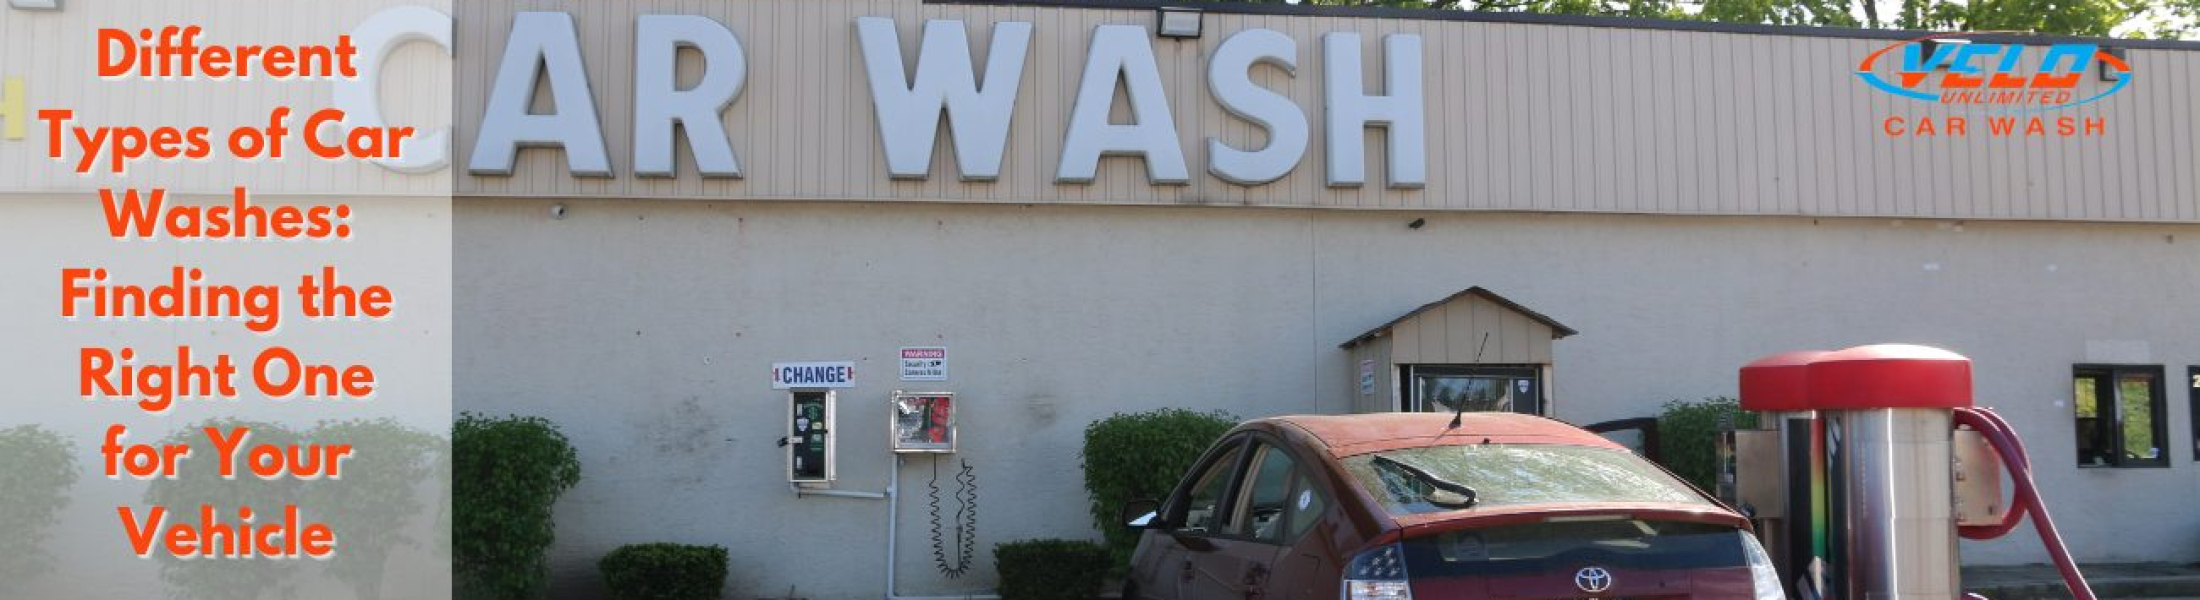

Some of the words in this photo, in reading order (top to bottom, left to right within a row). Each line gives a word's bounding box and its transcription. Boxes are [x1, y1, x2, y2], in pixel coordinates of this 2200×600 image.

[334, 5, 748, 179] CAR
[856, 16, 1427, 190] WASH
[782, 366, 846, 384] CHANGE
